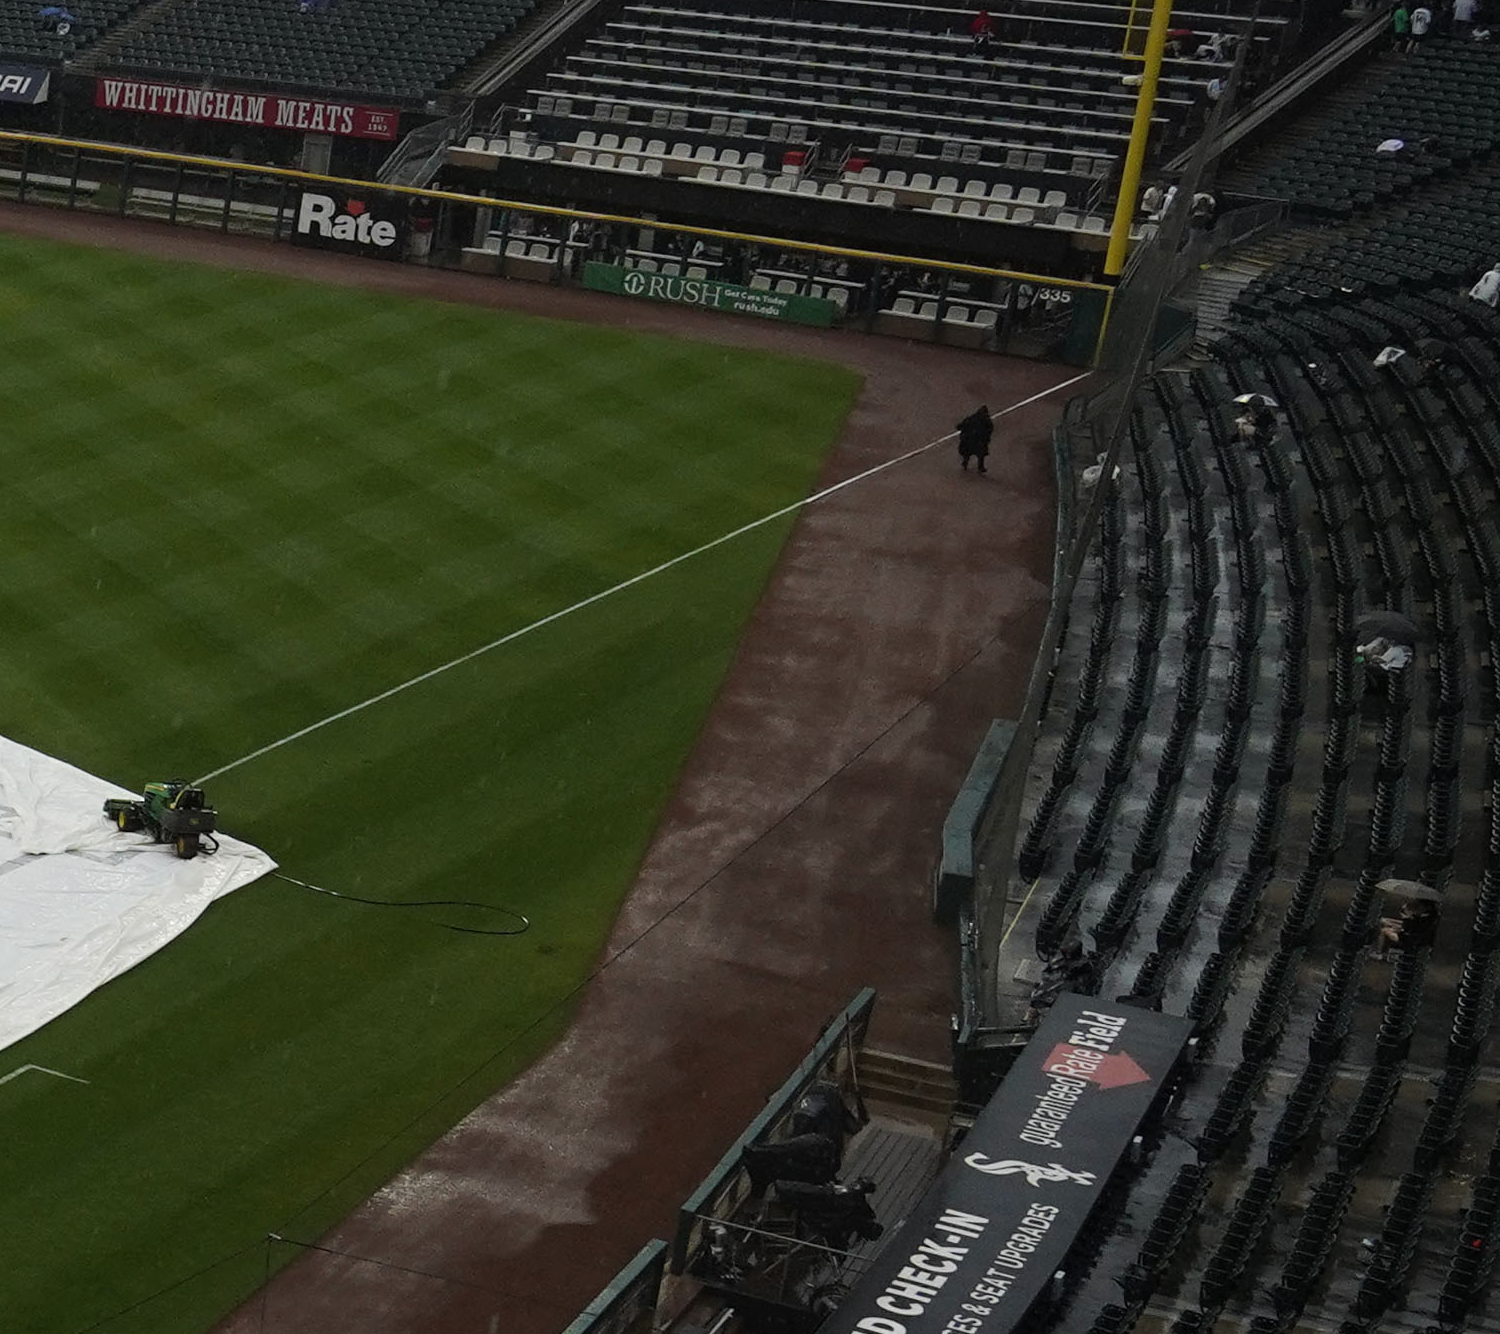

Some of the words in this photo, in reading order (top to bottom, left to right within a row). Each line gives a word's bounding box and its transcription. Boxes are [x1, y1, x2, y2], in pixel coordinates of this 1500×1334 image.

[102, 78, 270, 127] WHITTINGHAM
[274, 97, 356, 135] MEATS
[297, 191, 398, 249] Rate
[647, 276, 723, 309] RUSH
[733, 300, 780, 318] rush.edu
[1039, 287, 1072, 305] 335
[875, 1208, 991, 1318] CHECK-IN
[969, 1266, 1015, 1309] SEAT
[994, 1202, 1061, 1282] UPGRADES
